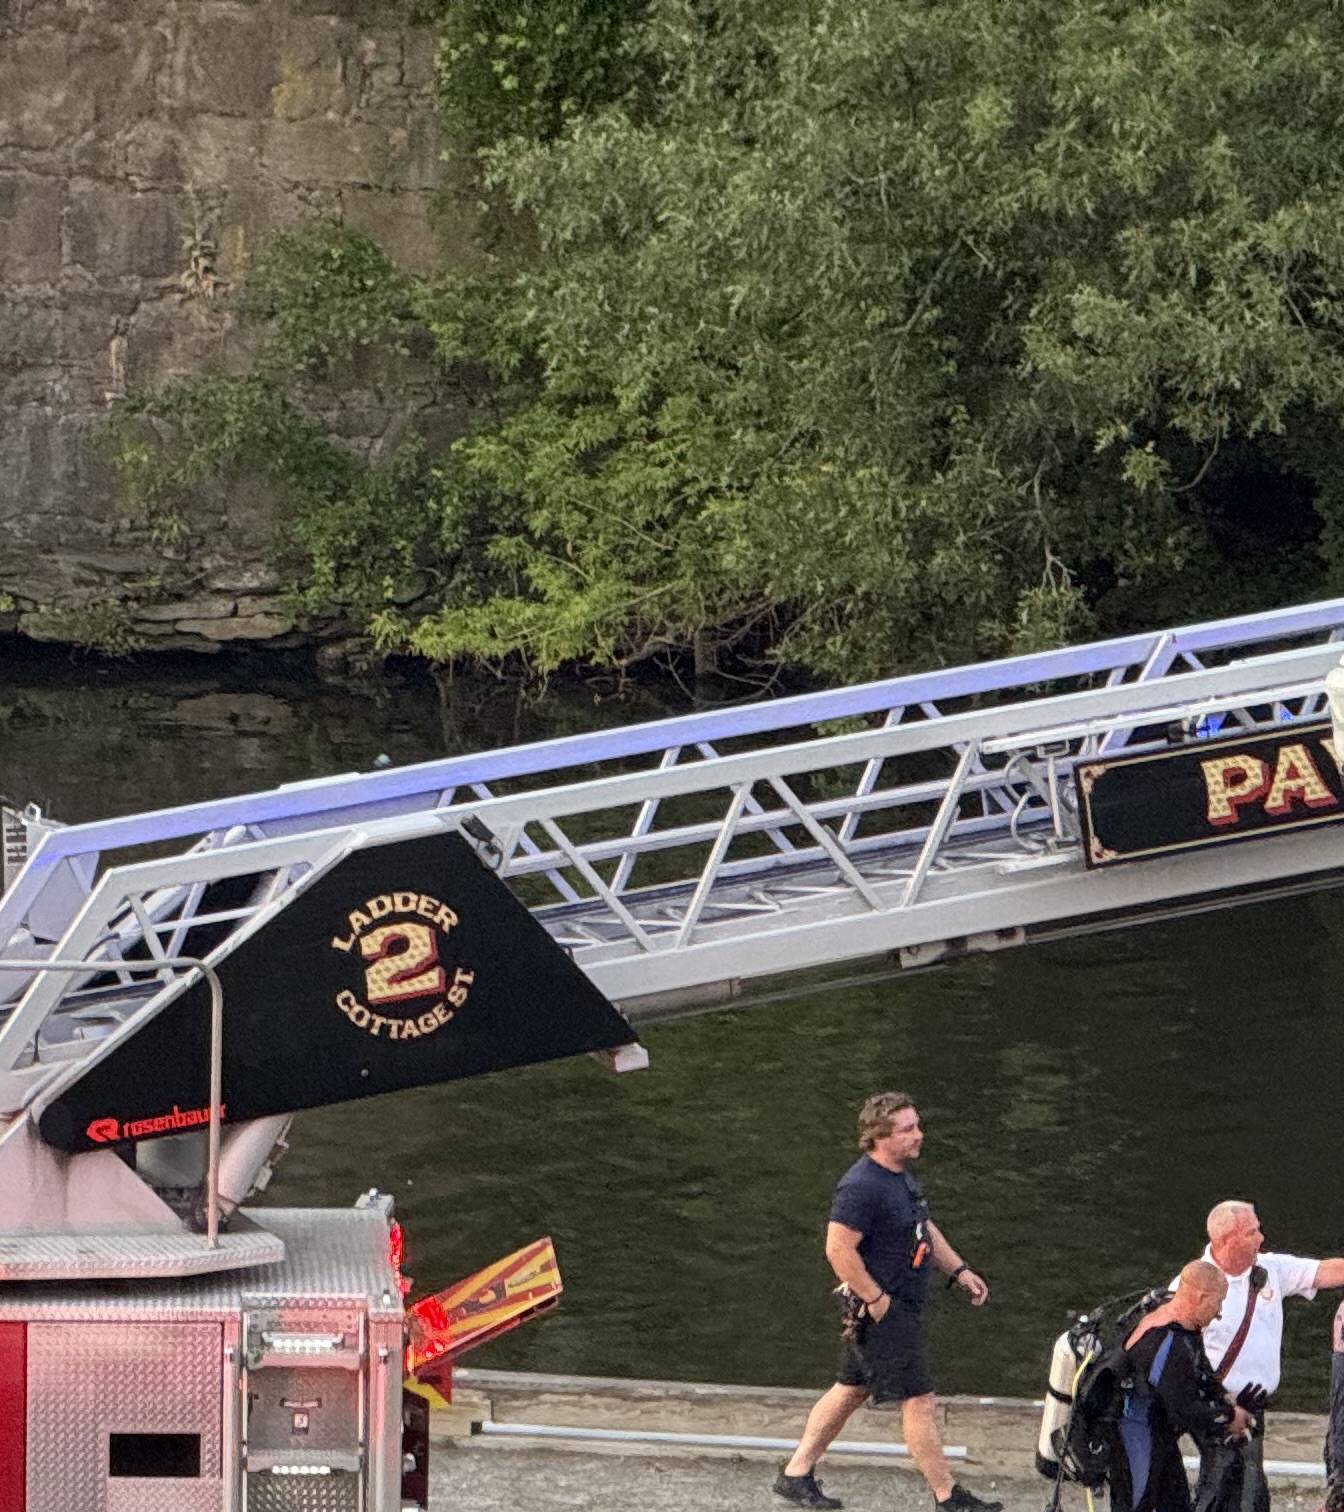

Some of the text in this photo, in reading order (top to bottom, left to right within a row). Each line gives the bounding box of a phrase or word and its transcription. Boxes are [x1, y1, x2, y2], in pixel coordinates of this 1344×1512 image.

[331, 890, 459, 952] LADDER
[359, 922, 446, 1005] 2
[336, 990, 454, 1040] COTTAGE
[123, 1104, 226, 1137] rosenbaur
